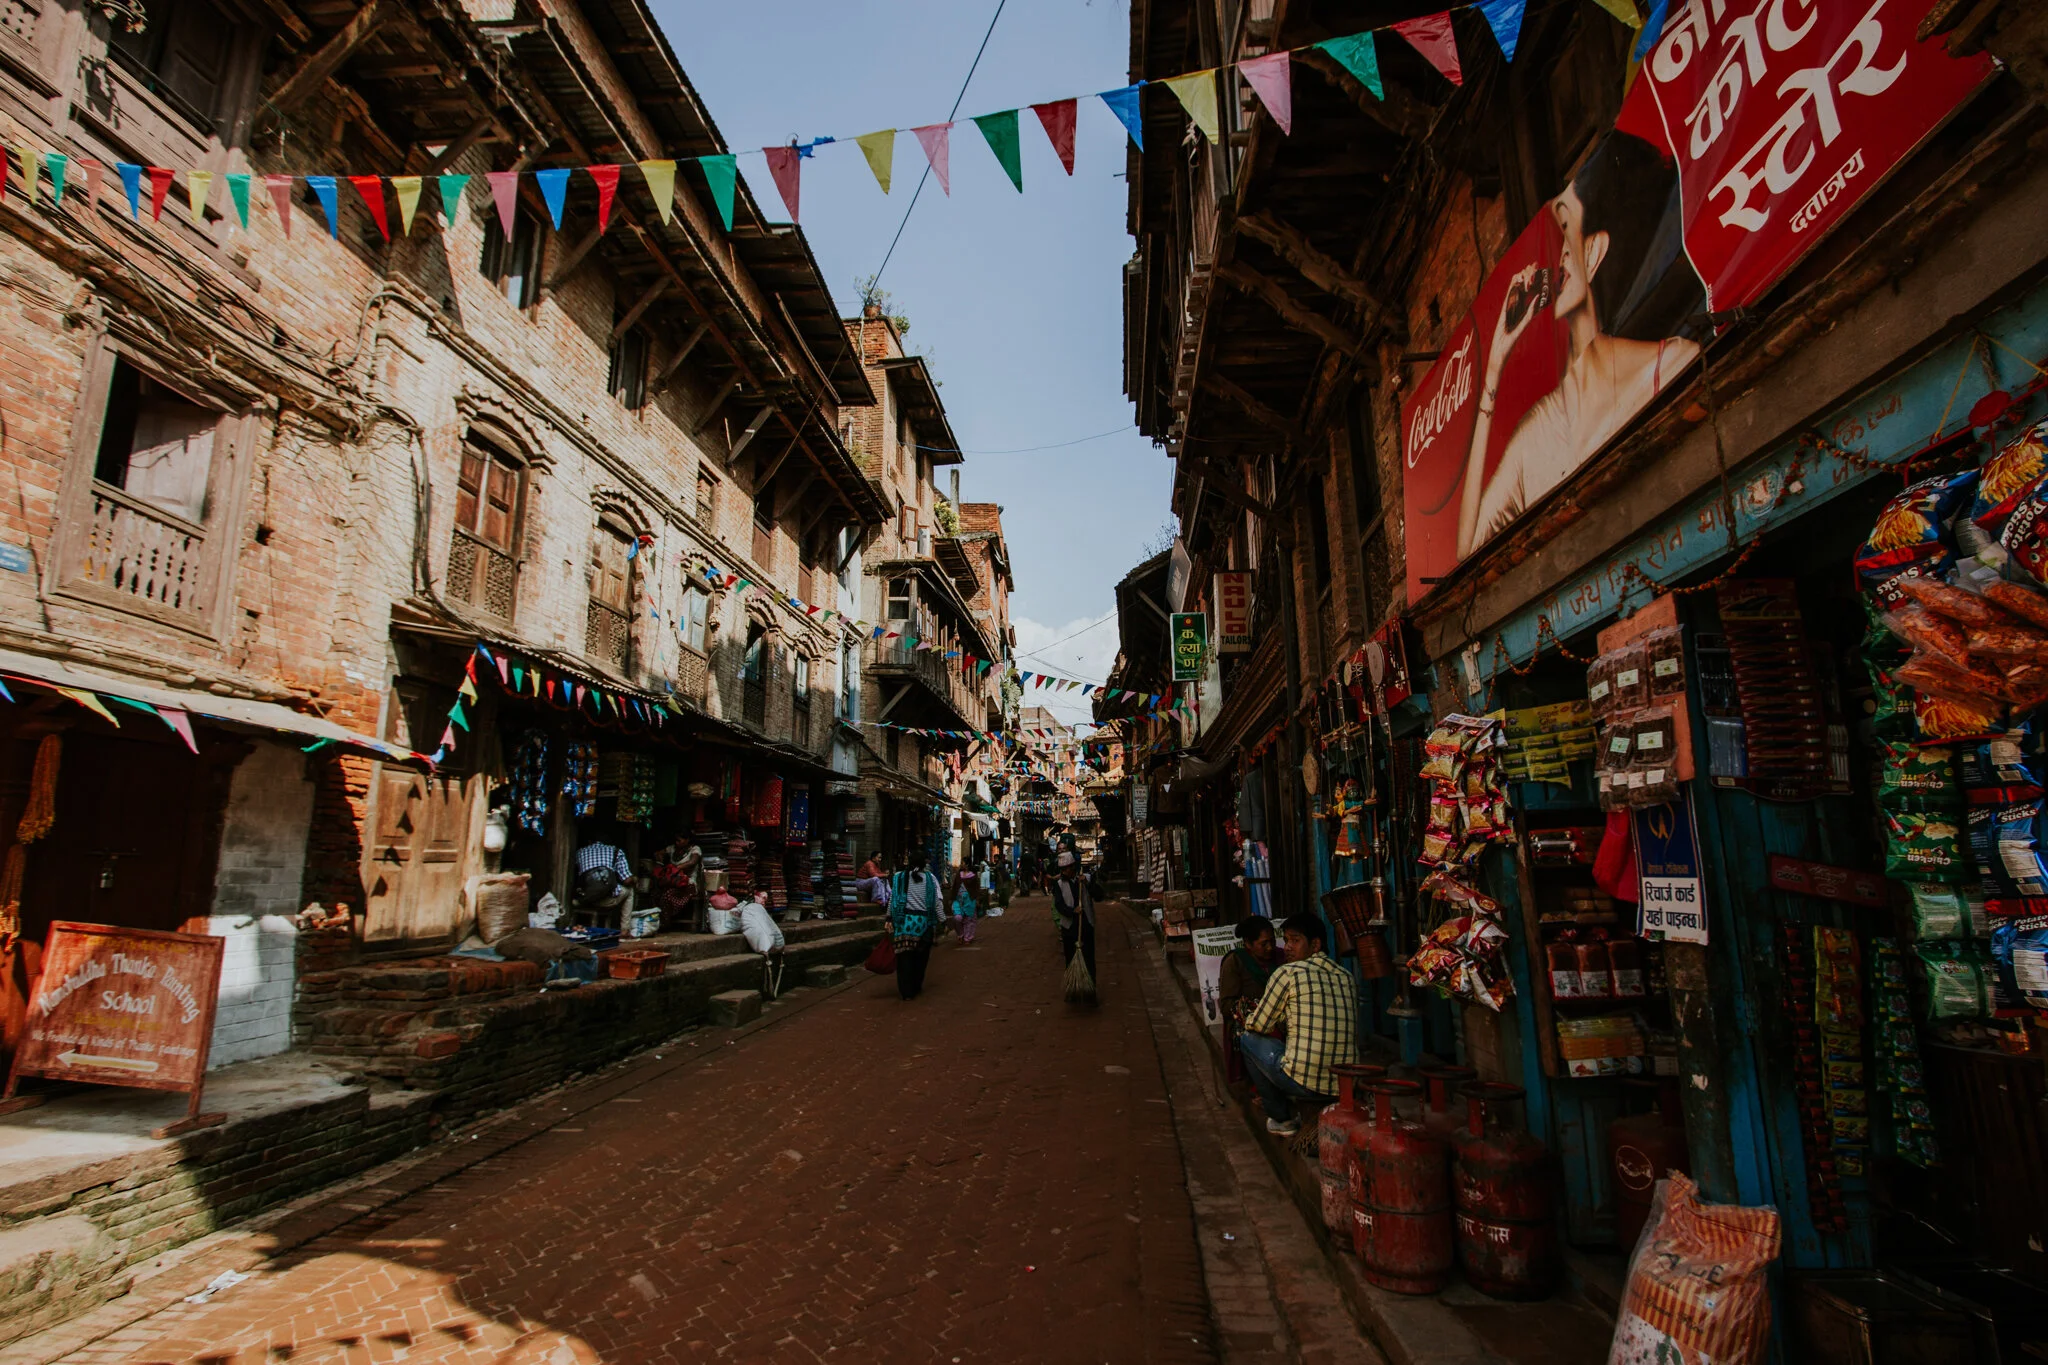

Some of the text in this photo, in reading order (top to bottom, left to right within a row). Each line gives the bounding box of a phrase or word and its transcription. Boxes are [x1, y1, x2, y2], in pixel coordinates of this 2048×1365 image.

[1708, 0, 1907, 232] स्टोर
[1407, 328, 1474, 469] Coca-Cola
[2011, 500, 2048, 550] Potato
[1876, 565, 1920, 595] Scks
[1223, 573, 1246, 634] NAULO
[2000, 809, 2038, 824] Sticks
[1645, 881, 1695, 902] रिचार्ज कार्ड
[100, 989, 157, 1015] School
